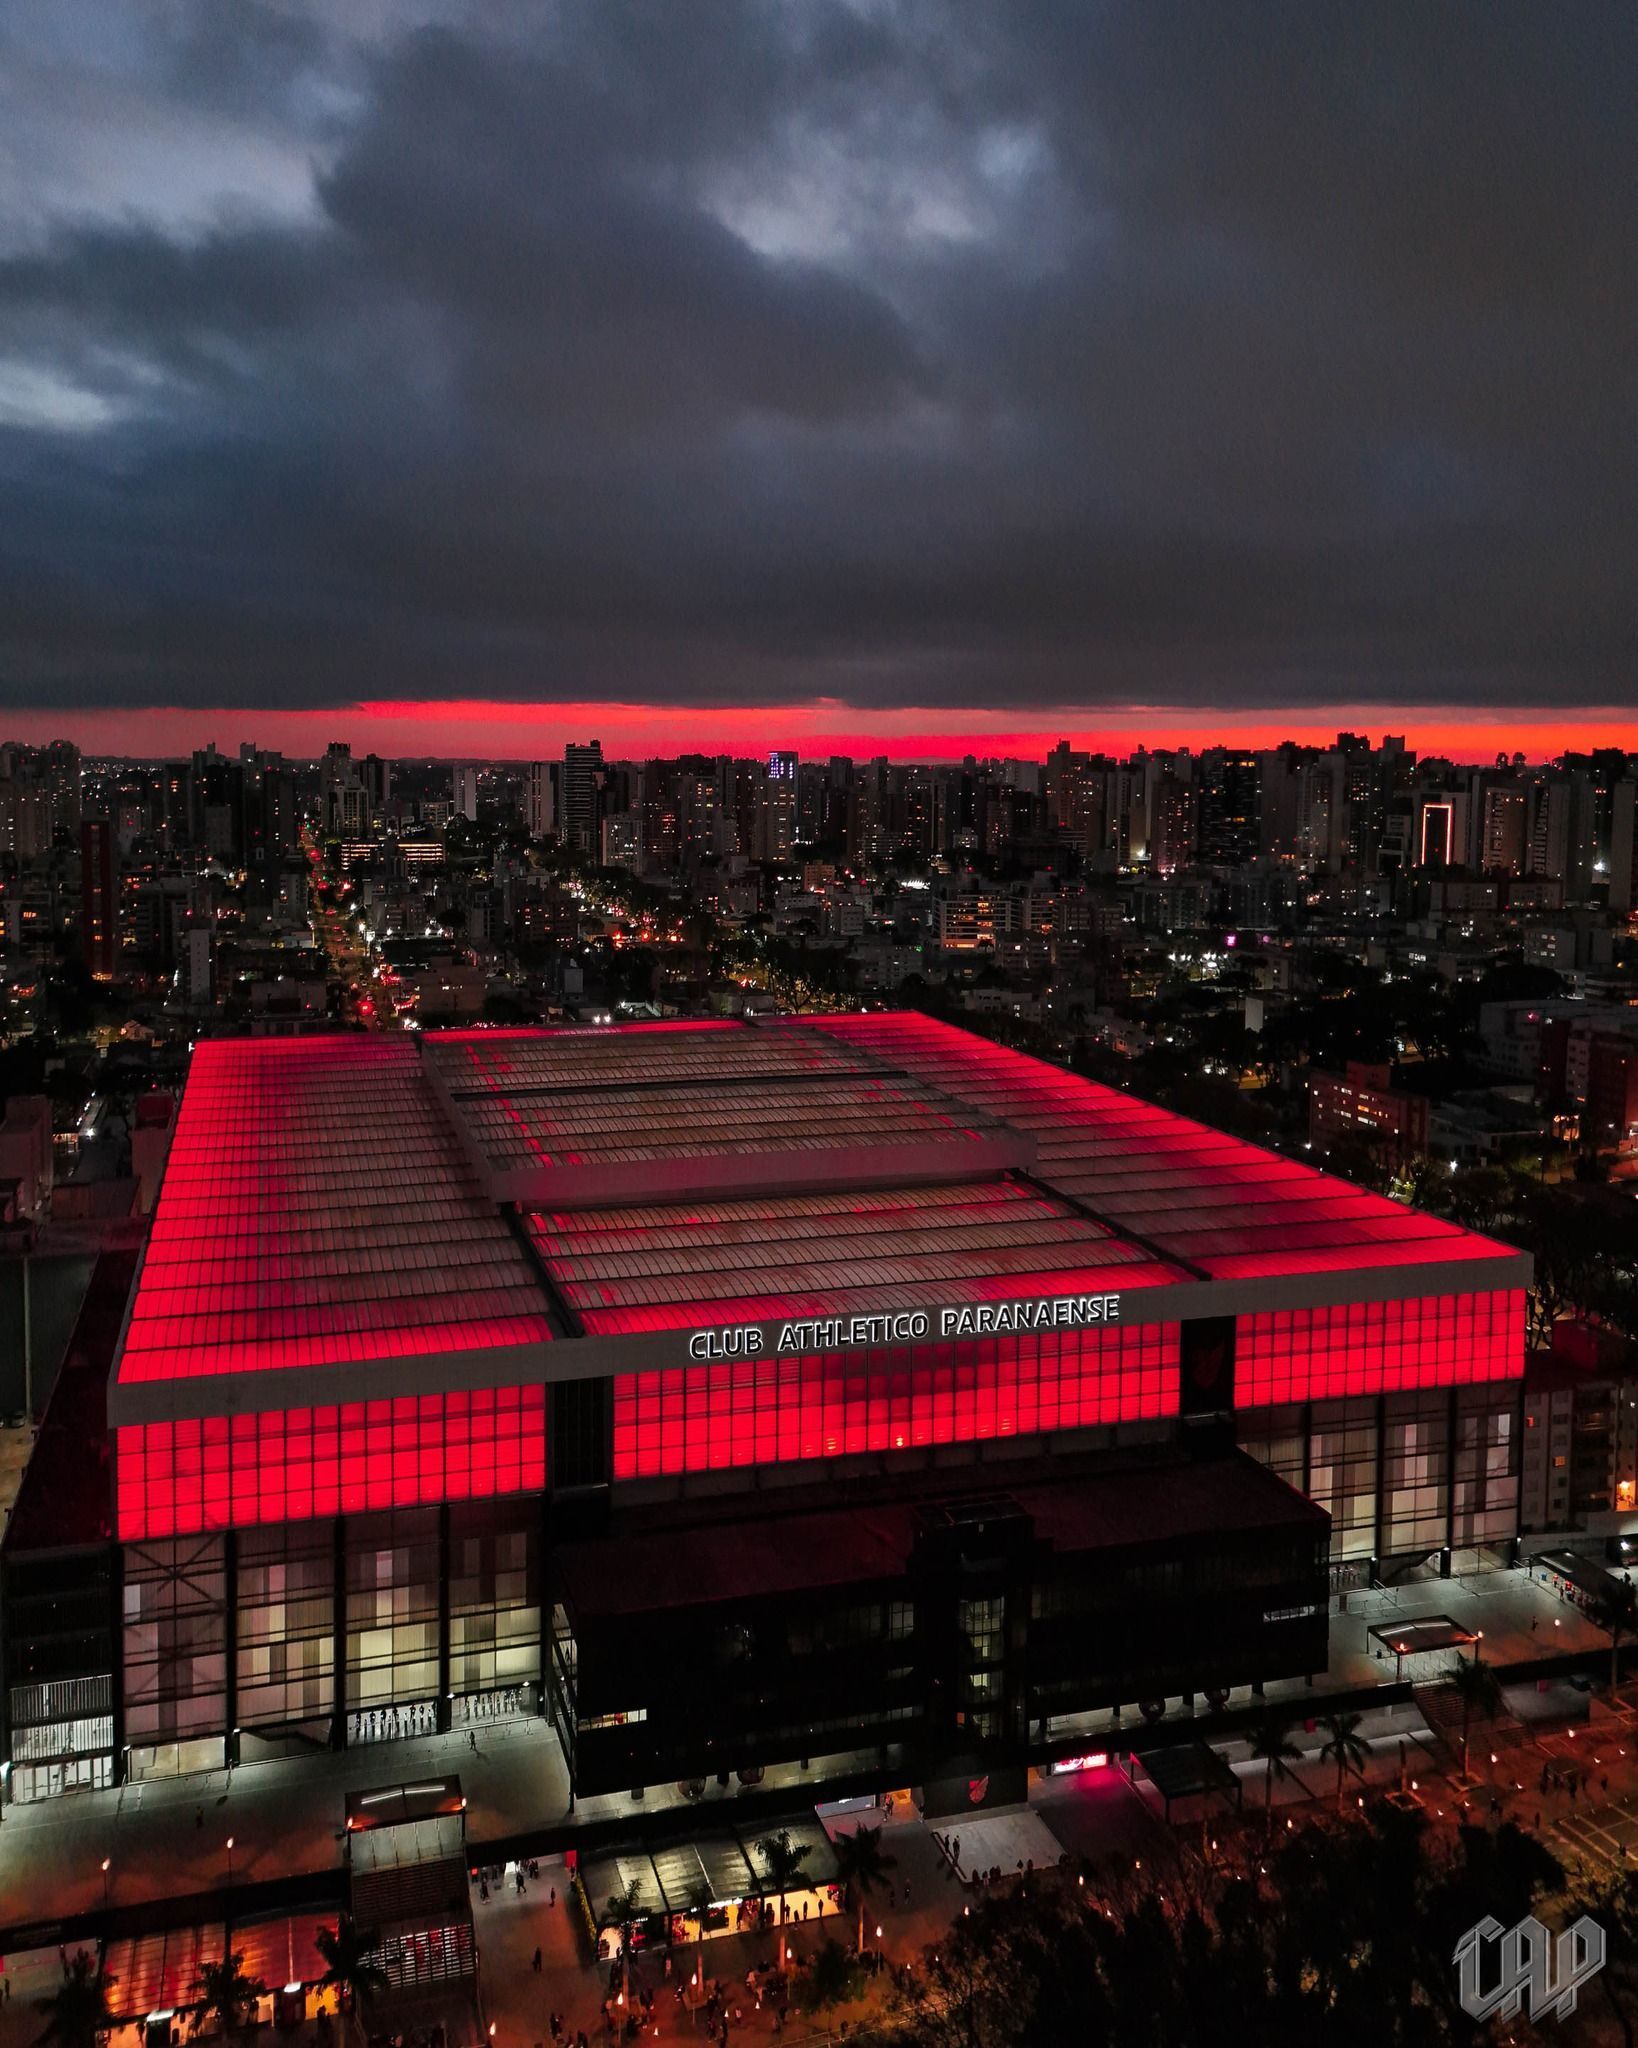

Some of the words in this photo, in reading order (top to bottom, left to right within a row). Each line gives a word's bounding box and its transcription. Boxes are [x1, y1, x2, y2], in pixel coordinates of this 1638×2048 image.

[689, 1328, 764, 1360] CLUB
[777, 1312, 929, 1352] ATHLETICO
[941, 1294, 1120, 1336] PARANAENSE
